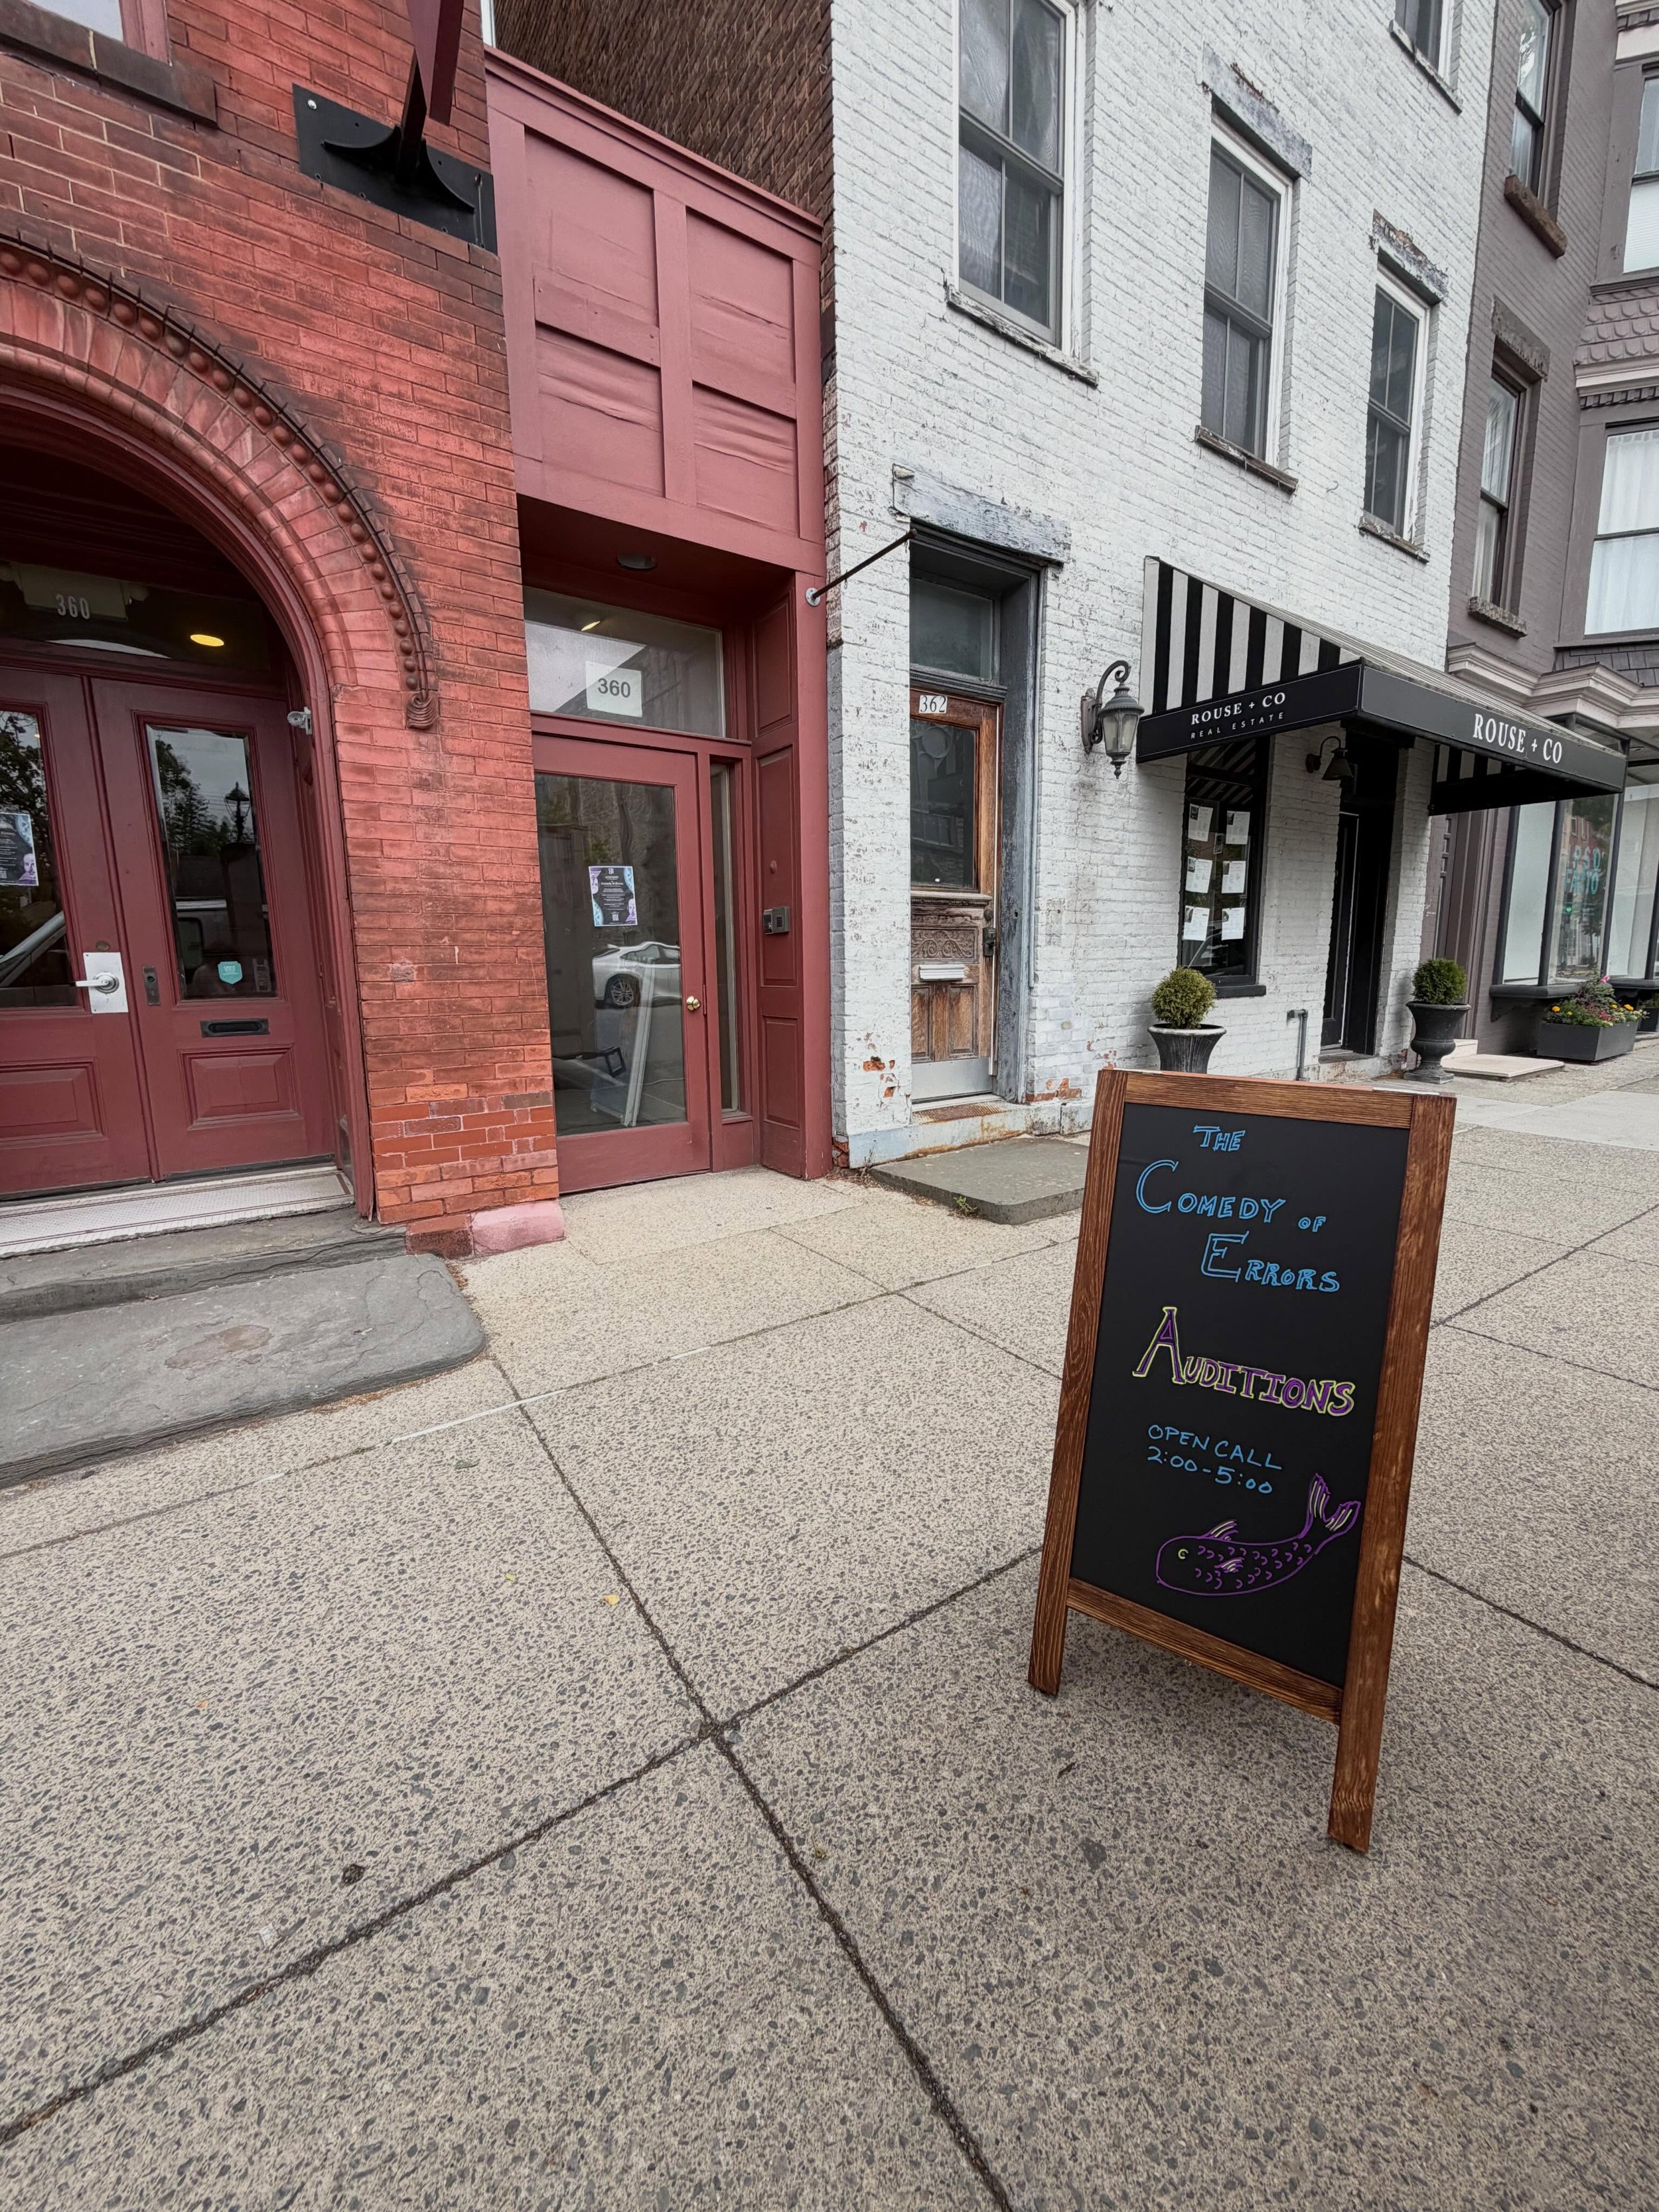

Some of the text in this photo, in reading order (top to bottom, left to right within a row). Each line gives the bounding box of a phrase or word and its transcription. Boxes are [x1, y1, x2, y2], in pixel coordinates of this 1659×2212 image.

[56, 593, 90, 620] 360
[597, 678, 631, 698] 360
[920, 695, 946, 713] 362
[1190, 702, 1242, 725] ROUSE
[1262, 692, 1285, 707] CO
[1190, 711, 1283, 739] REAL ESTATE
[1473, 713, 1526, 753] ROUSE
[1543, 738, 1562, 764] CO
[1563, 869, 1599, 895] FATO
[1192, 1125, 1246, 1152] THE
[1135, 1159, 1327, 1233] COMEDY OF
[1200, 1230, 1340, 1293] ERRORS
[1131, 1306, 1356, 1417] AUDITIONS
[1147, 1424, 1283, 1471] OPEN CALL
